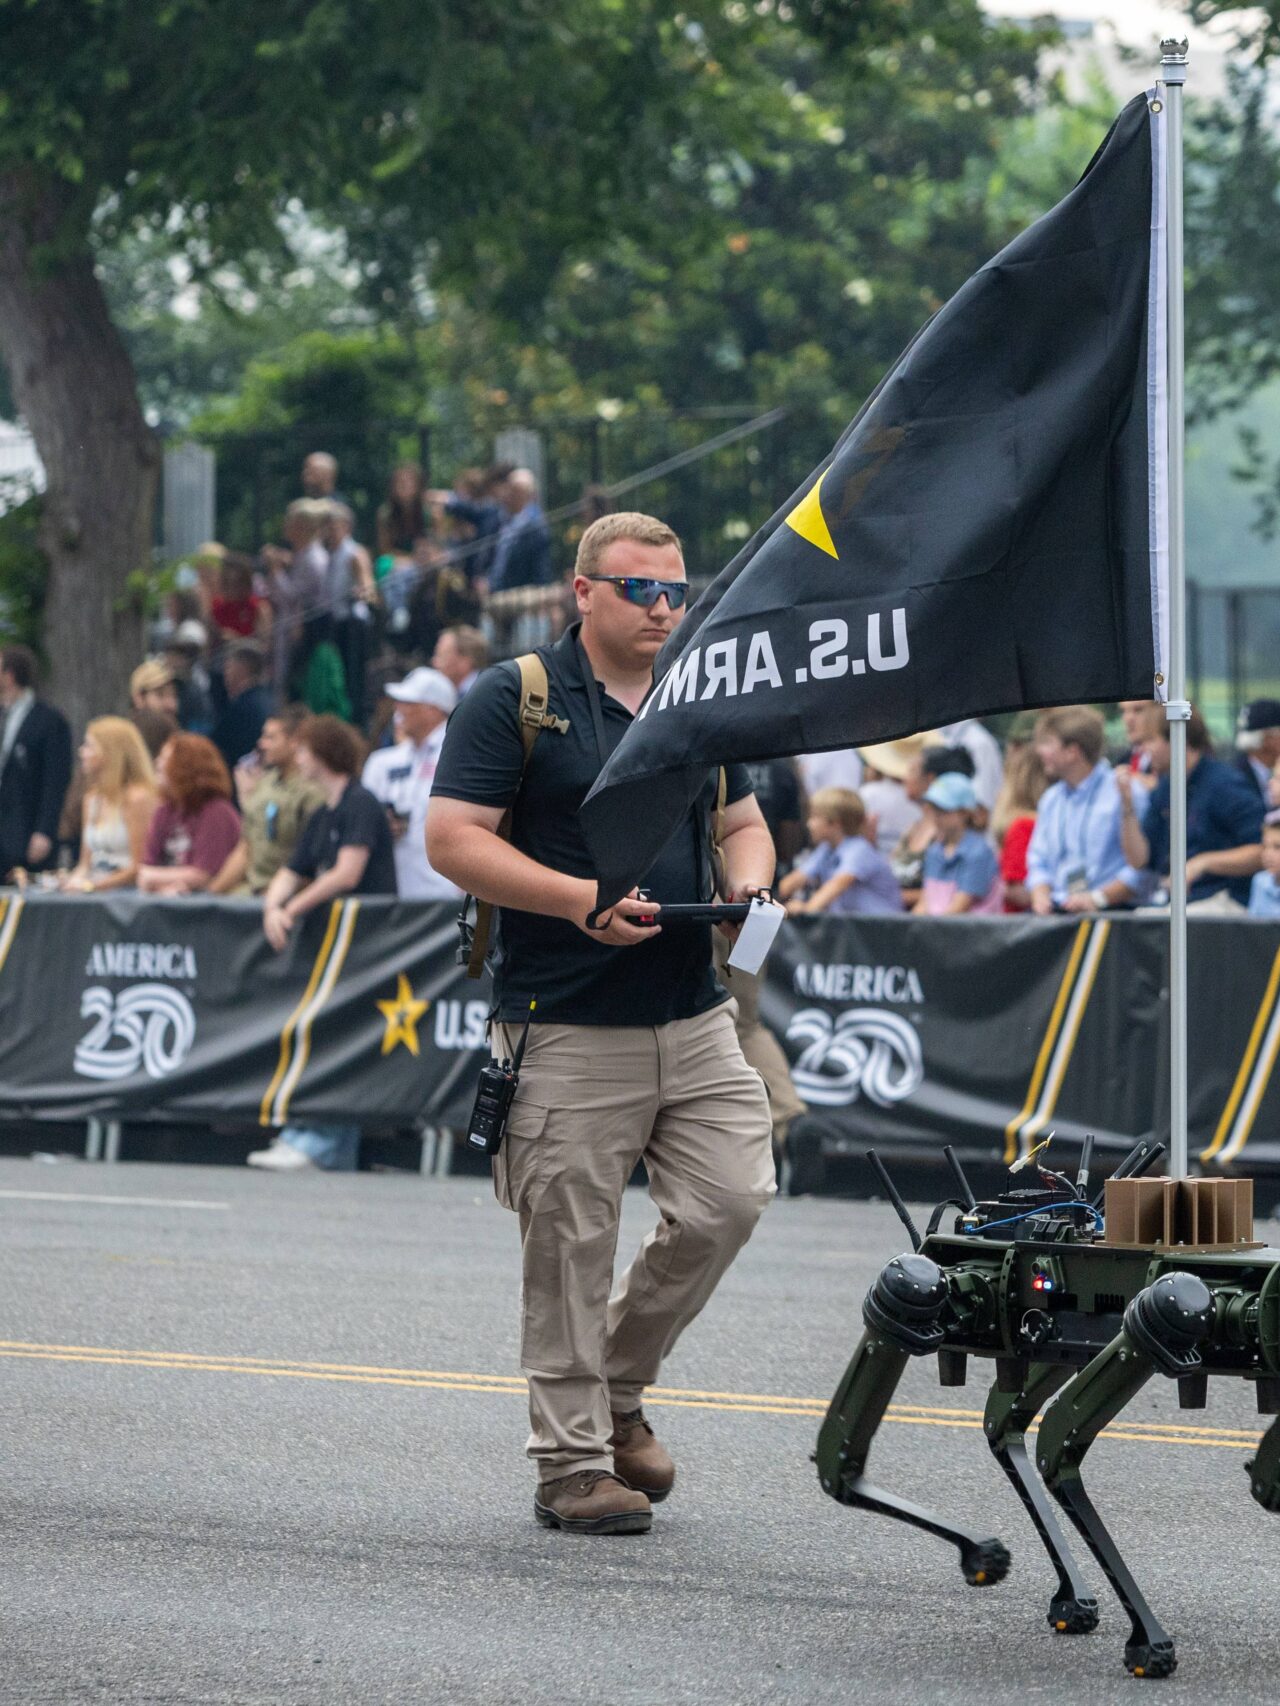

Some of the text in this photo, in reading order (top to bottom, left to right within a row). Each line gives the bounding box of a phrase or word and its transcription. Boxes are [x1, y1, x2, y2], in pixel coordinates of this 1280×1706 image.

[85, 942, 198, 978] AMERICA
[73, 982, 197, 1080] 250
[785, 1007, 925, 1109] 250
